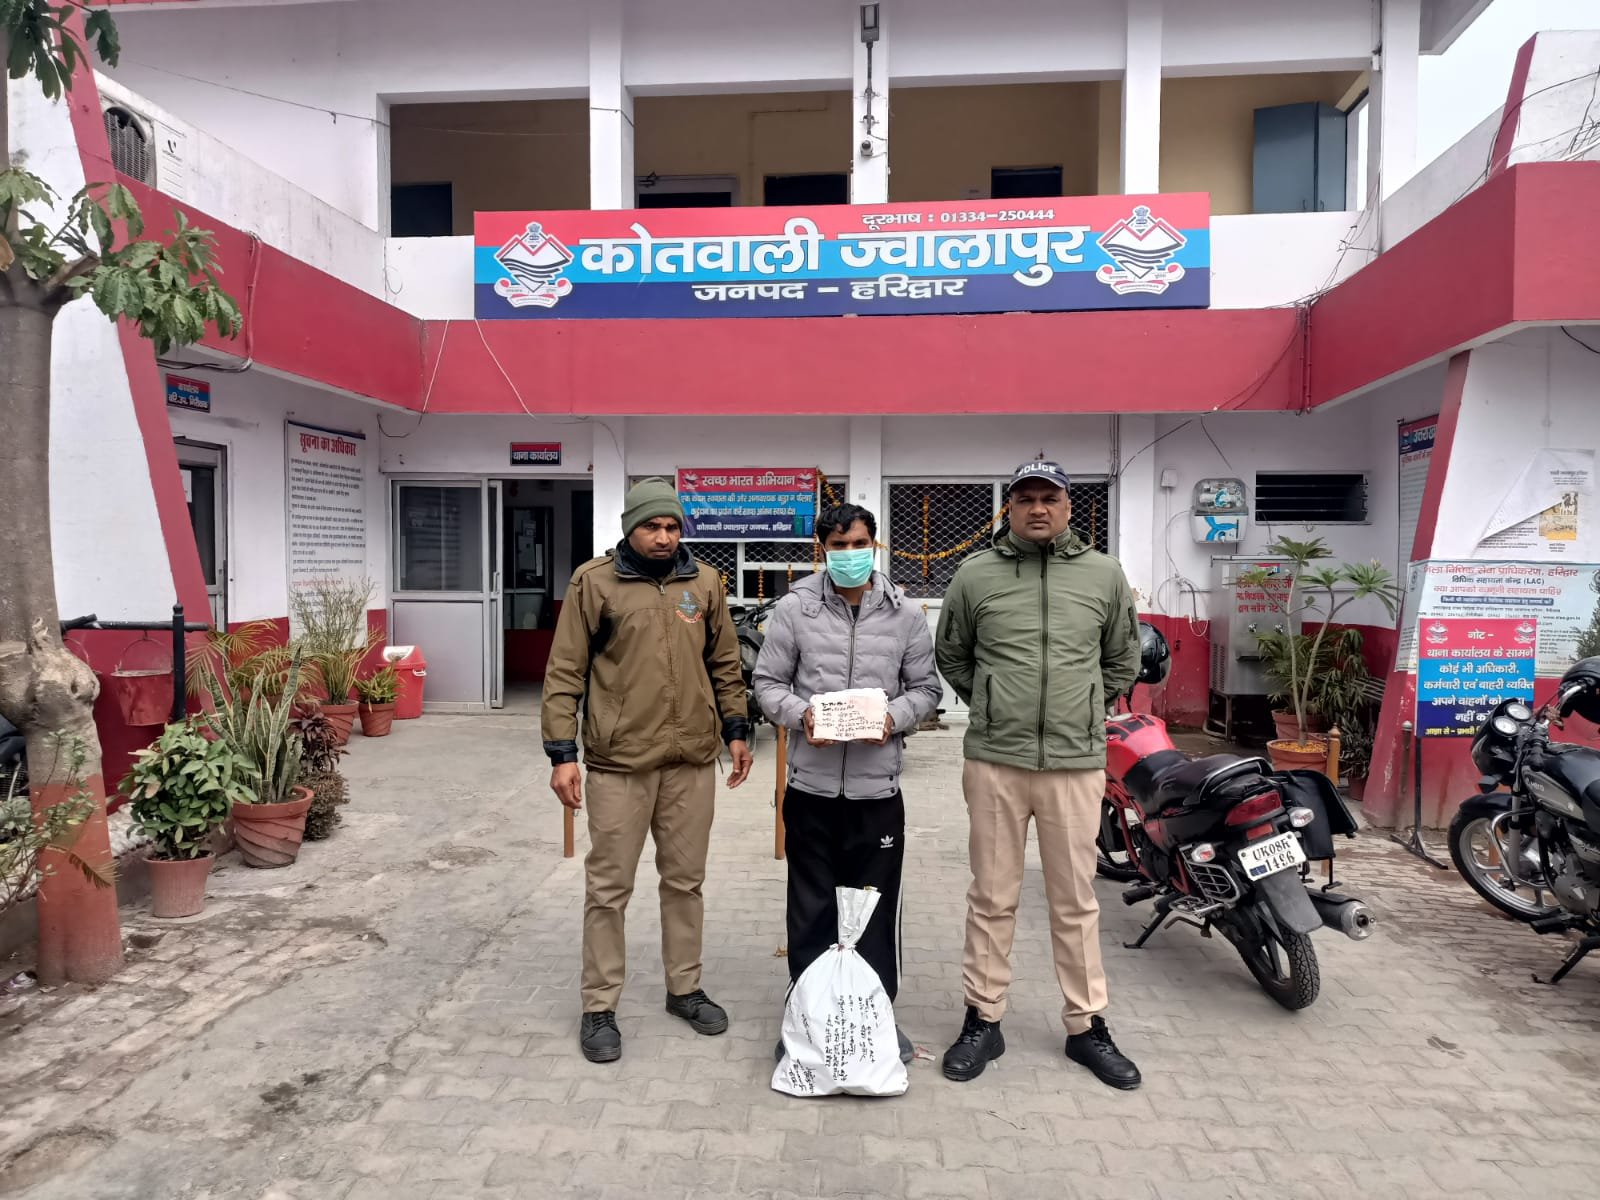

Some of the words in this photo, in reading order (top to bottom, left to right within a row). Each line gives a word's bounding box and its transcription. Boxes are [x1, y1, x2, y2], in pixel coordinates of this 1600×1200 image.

[862, 213, 923, 231] दूरभाष
[940, 209, 1056, 223] 01334-250444
[578, 217, 825, 275] कोतवाली
[837, 225, 1092, 288] ज्वालापुर
[691, 282, 808, 301] जनपद
[850, 273, 968, 300] हरिद्वार
[300, 432, 320, 453] सूचना
[321, 436, 330, 452] का
[331, 436, 357, 457] अधिकार
[529, 447, 558, 461] कार्यालय
[1017, 462, 1057, 477] POLICE
[702, 475, 728, 487] स्वच्छ
[729, 475, 754, 486] भारत
[756, 471, 795, 486] अभियान
[1467, 628, 1486, 640] नोट
[1427, 648, 1449, 658] थाना
[1451, 646, 1491, 658] कार्यालय
[1493, 646, 1503, 658] के
[1505, 646, 1534, 658] सामने
[1439, 662, 1459, 675] कोई
[1462, 662, 1474, 674] भी
[1423, 678, 1460, 690] कर्मचारी
[1463, 678, 1479, 690] एवं
[1506, 678, 1535, 690] व्यक्ति
[1431, 694, 1457, 706] अपने
[1458, 694, 1488, 707] वाहनों
[1488, 694, 1502, 706] को
[1455, 709, 1476, 723] नहीं
